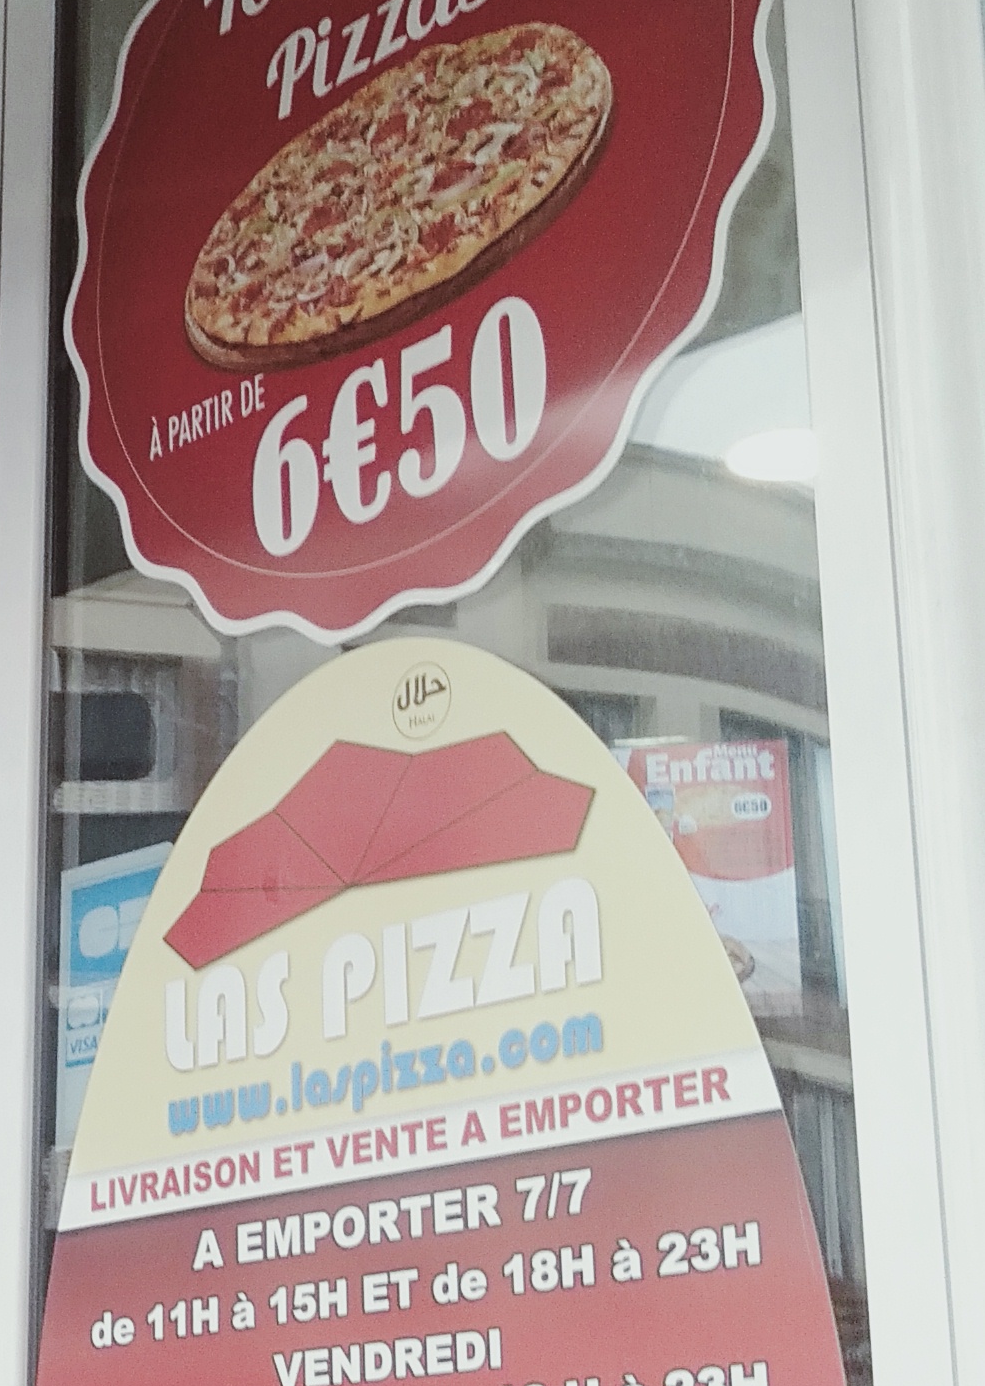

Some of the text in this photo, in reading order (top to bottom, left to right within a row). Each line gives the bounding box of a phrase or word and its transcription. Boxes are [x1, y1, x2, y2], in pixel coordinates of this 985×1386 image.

[149, 373, 265, 462] À PARTIR DE
[252, 296, 547, 557] 6€50
[397, 673, 446, 711] حلال
[645, 747, 775, 783] Enfant
[165, 877, 603, 1072] LAS PIZZA
[69, 1035, 98, 1056] VISA
[168, 1013, 603, 1135] www.laspizza.com
[90, 1066, 731, 1212] LIVRAISON ET VENTE A EMPORTER
[191, 1168, 592, 1271] A EMPORTER 7/7
[91, 1221, 762, 1349] de 11H à 15H ET de 18H à 23H
